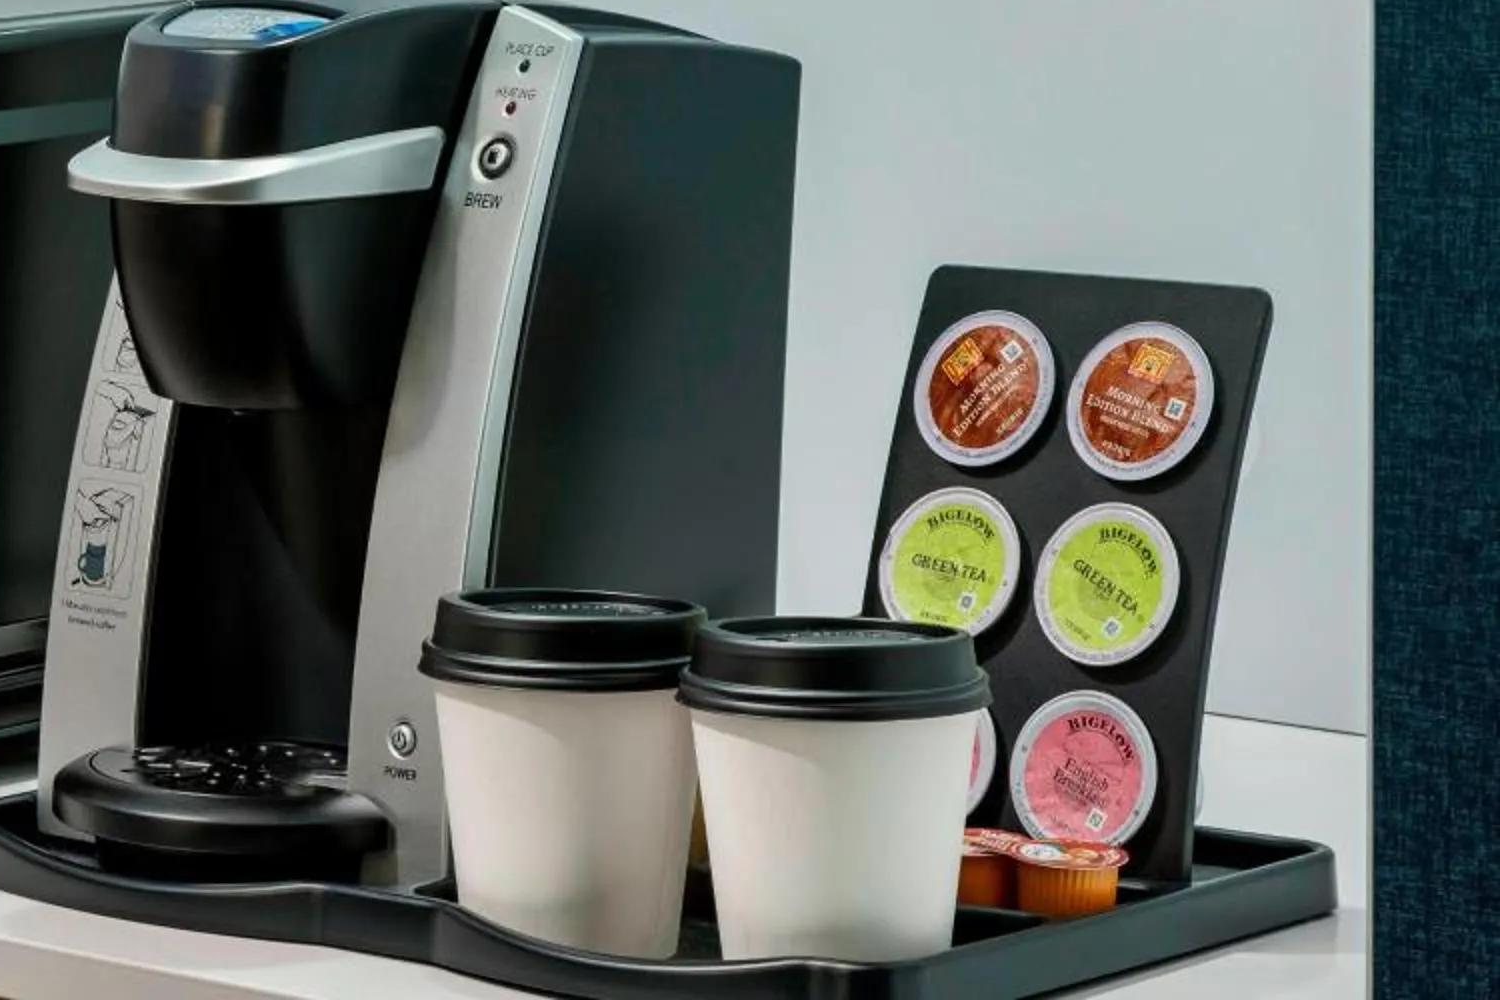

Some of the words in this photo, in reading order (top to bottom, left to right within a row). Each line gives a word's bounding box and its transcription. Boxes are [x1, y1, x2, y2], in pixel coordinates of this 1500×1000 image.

[463, 191, 503, 209] BREW
[927, 509, 995, 539] BIGELOW
[911, 553, 959, 577] GREEN
[961, 565, 986, 582] TEA
[1099, 527, 1157, 574] BIGELOW
[1073, 559, 1116, 596] GREEN
[1115, 588, 1139, 616] TEA
[1067, 715, 1135, 762] BIGELOW
